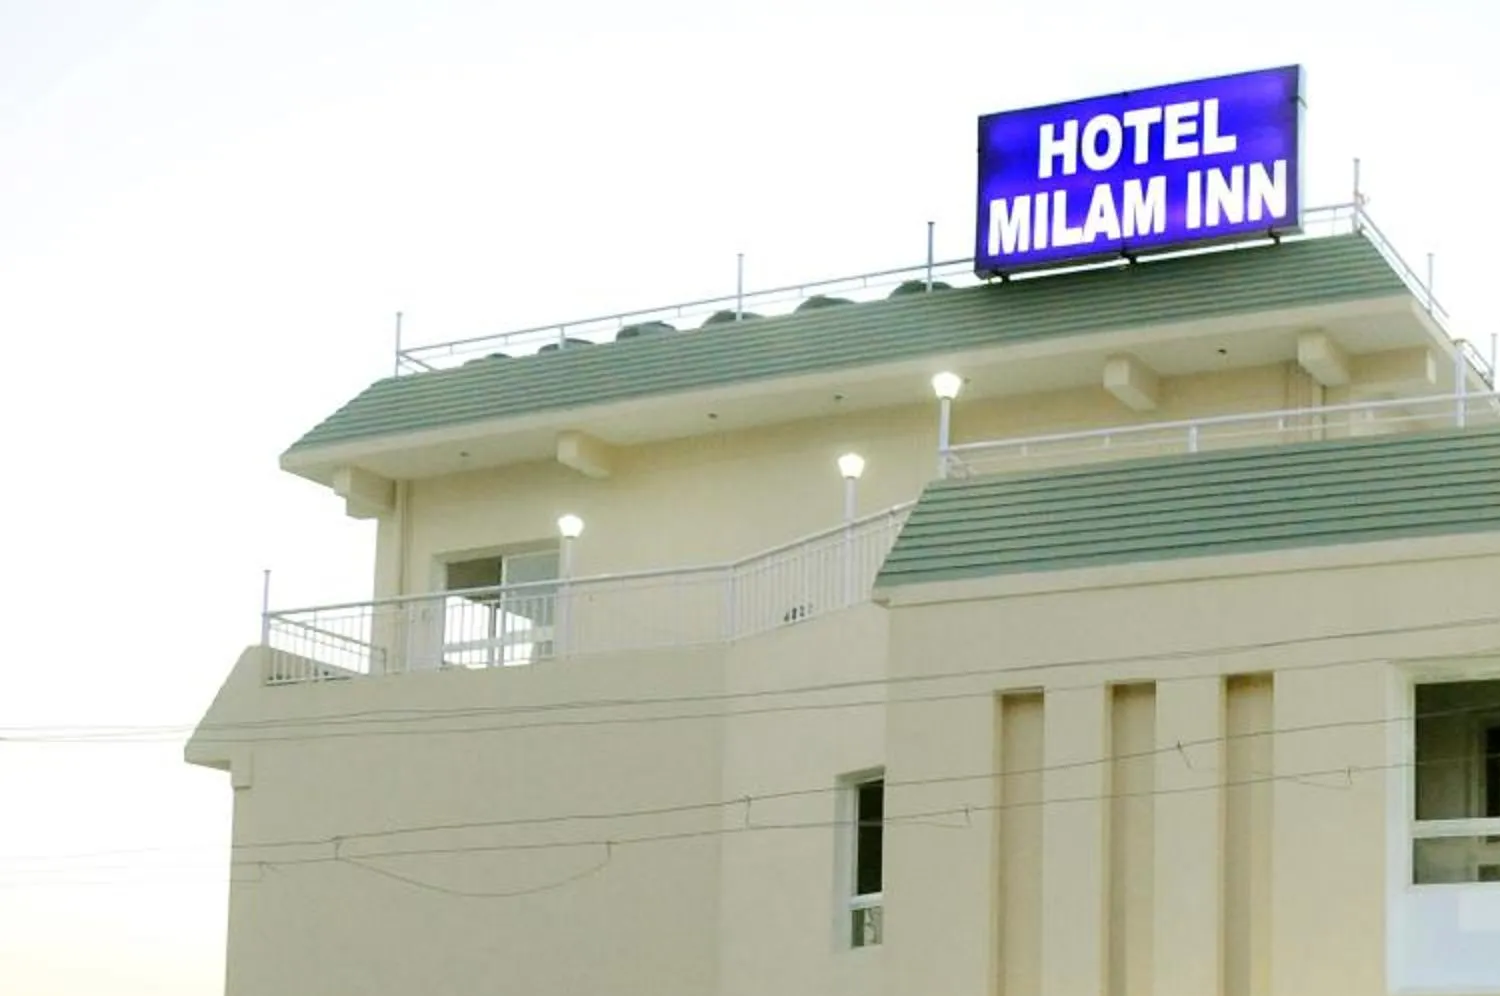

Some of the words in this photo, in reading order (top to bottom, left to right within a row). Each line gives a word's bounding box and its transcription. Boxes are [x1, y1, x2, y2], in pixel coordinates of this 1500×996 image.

[1038, 98, 1237, 179] HOTEL
[987, 175, 1167, 257] MILAM
[1186, 159, 1288, 230] INN
